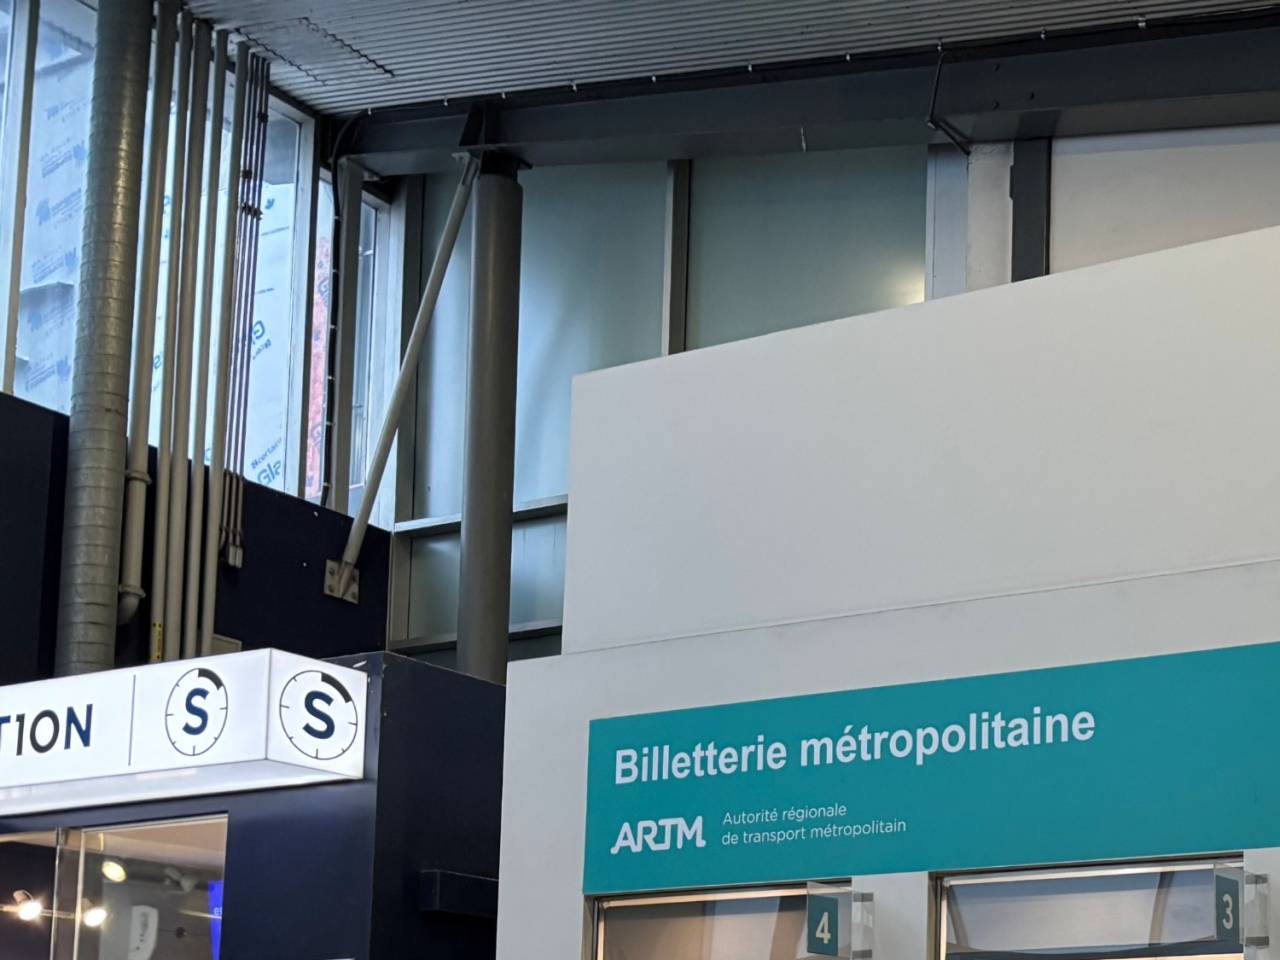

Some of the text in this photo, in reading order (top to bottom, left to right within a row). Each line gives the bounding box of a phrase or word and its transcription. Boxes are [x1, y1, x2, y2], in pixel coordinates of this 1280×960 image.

[182, 687, 210, 736] S
[302, 690, 335, 740] S
[615, 706, 1096, 785] Billetterie métropolitaine
[721, 819, 907, 845] de transport métropolitain
[722, 802, 847, 825] Autorité régionale
[610, 815, 706, 854] ARTM
[815, 911, 831, 944] 4
[1222, 894, 1233, 930] 3
